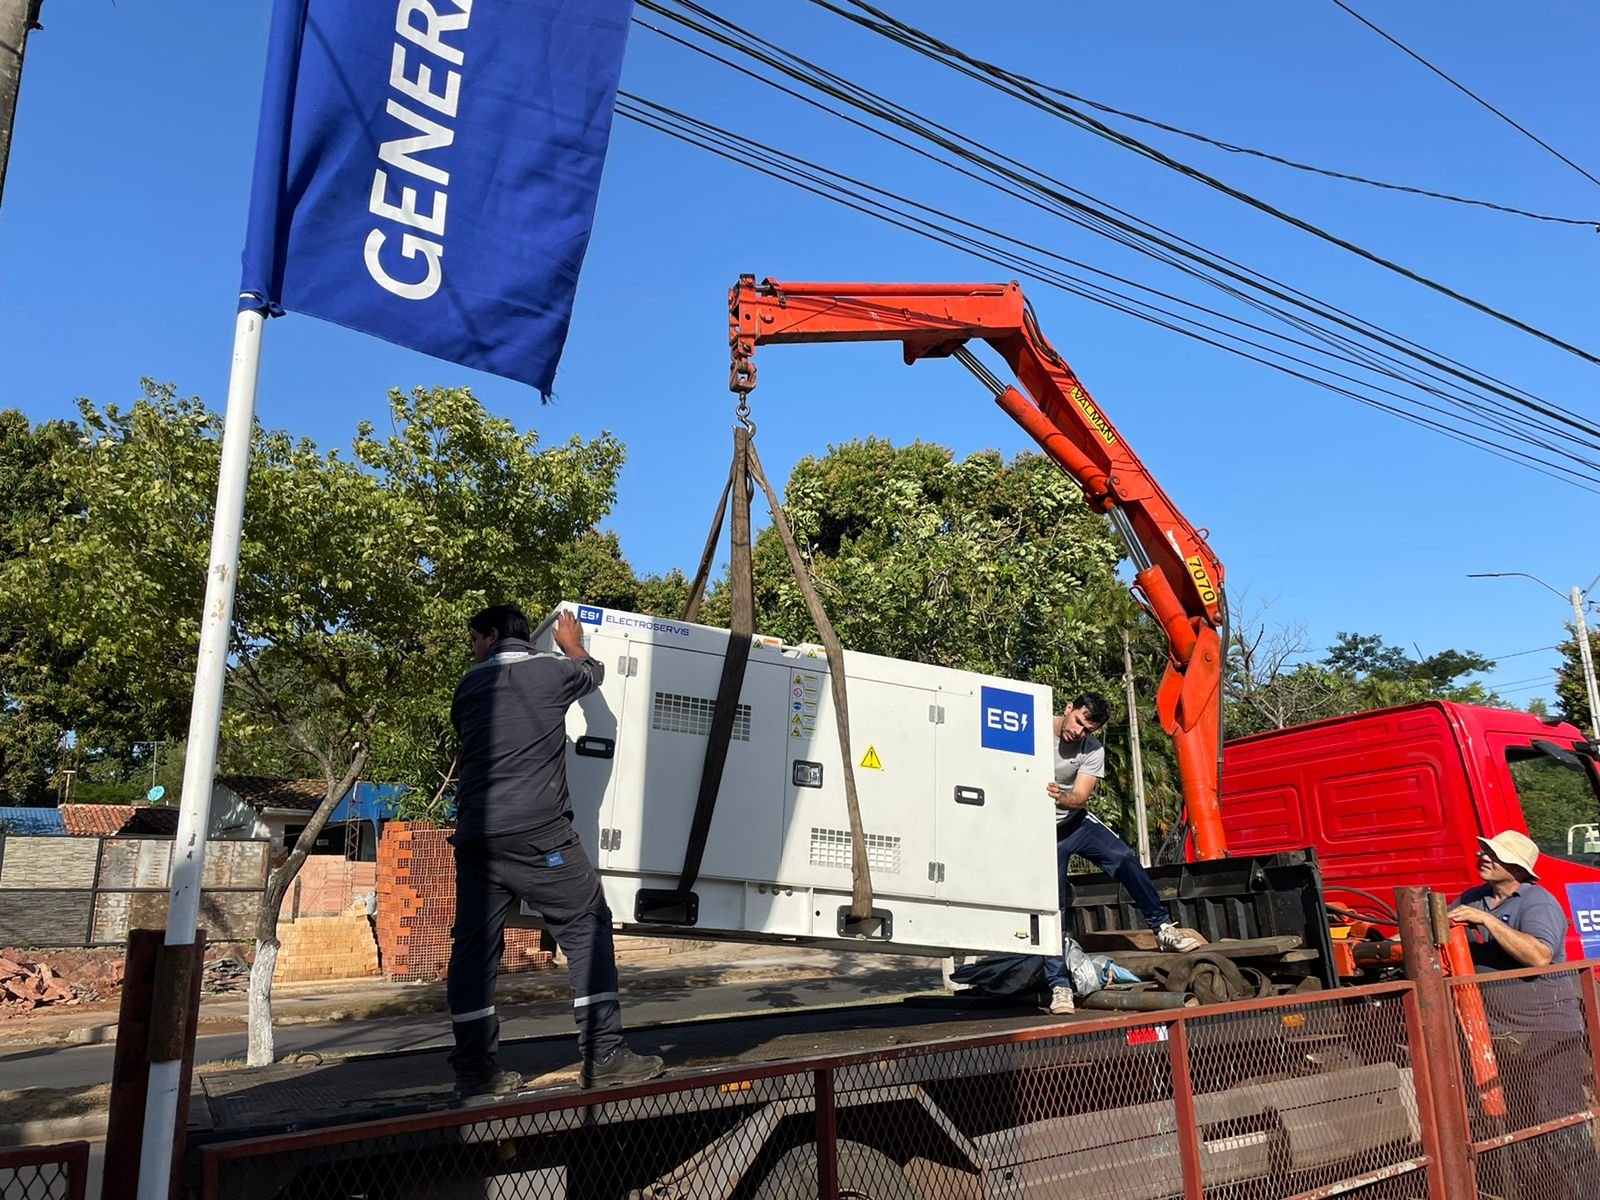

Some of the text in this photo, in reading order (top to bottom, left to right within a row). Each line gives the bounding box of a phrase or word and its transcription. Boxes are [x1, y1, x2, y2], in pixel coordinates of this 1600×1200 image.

[1074, 388, 1114, 441] VALMAN
[1189, 557, 1215, 601] 7070
[606, 615, 690, 636] ELECTROSERVIS
